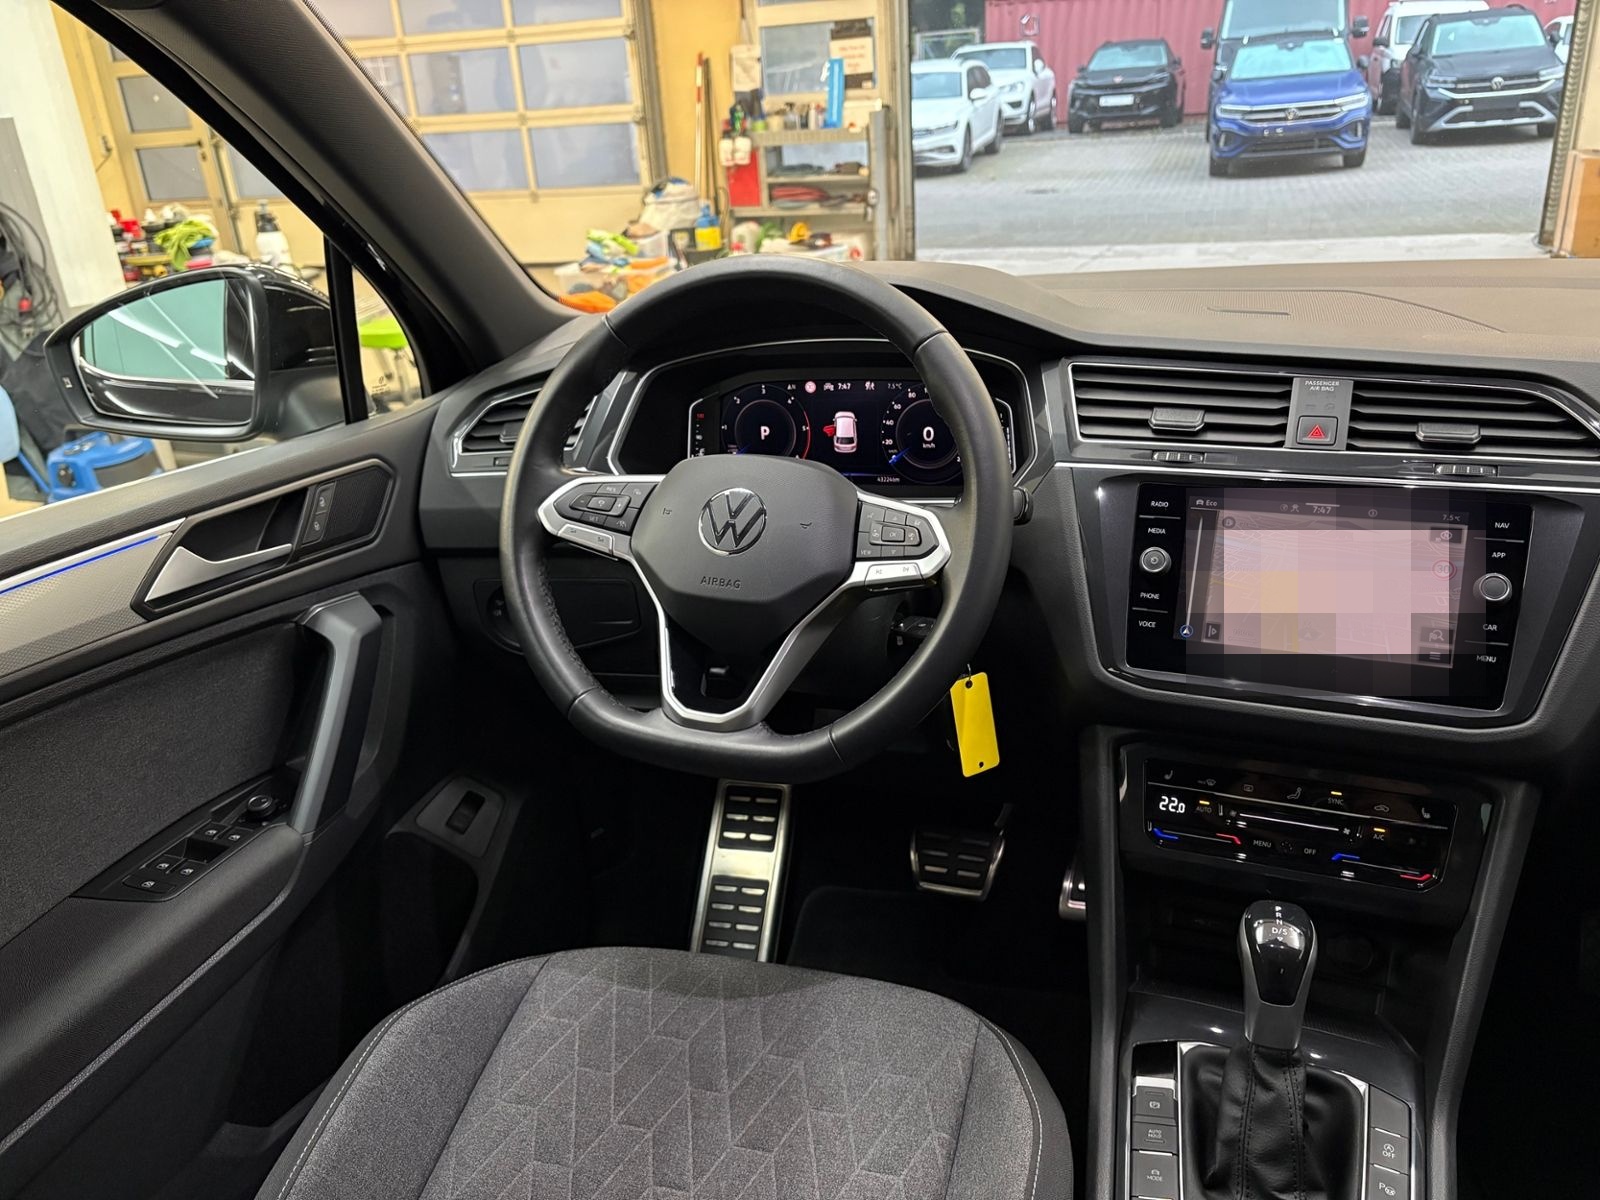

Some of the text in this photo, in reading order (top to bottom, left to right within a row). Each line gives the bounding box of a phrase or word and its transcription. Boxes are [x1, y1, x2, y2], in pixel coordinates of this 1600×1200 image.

[837, 382, 851, 390] 7:47
[760, 425, 770, 441] P
[922, 426, 935, 442] 0
[1150, 500, 1169, 508] RADIO
[1312, 506, 1332, 515] 7:47
[1494, 521, 1510, 529] NAV
[1147, 527, 1166, 535] MEDIA
[700, 576, 741, 589] AIRBAG
[1140, 592, 1160, 600] PHONE
[1138, 620, 1156, 628] VOICE
[1482, 623, 1498, 631] CAR
[1476, 655, 1497, 663] MENU
[1159, 795, 1186, 814] 22.0
[1327, 797, 1344, 806] SYNC
[1195, 806, 1212, 814] AUTO
[1373, 833, 1385, 842] A/C
[1252, 839, 1272, 848] MENU
[1271, 927, 1288, 936] D/S
